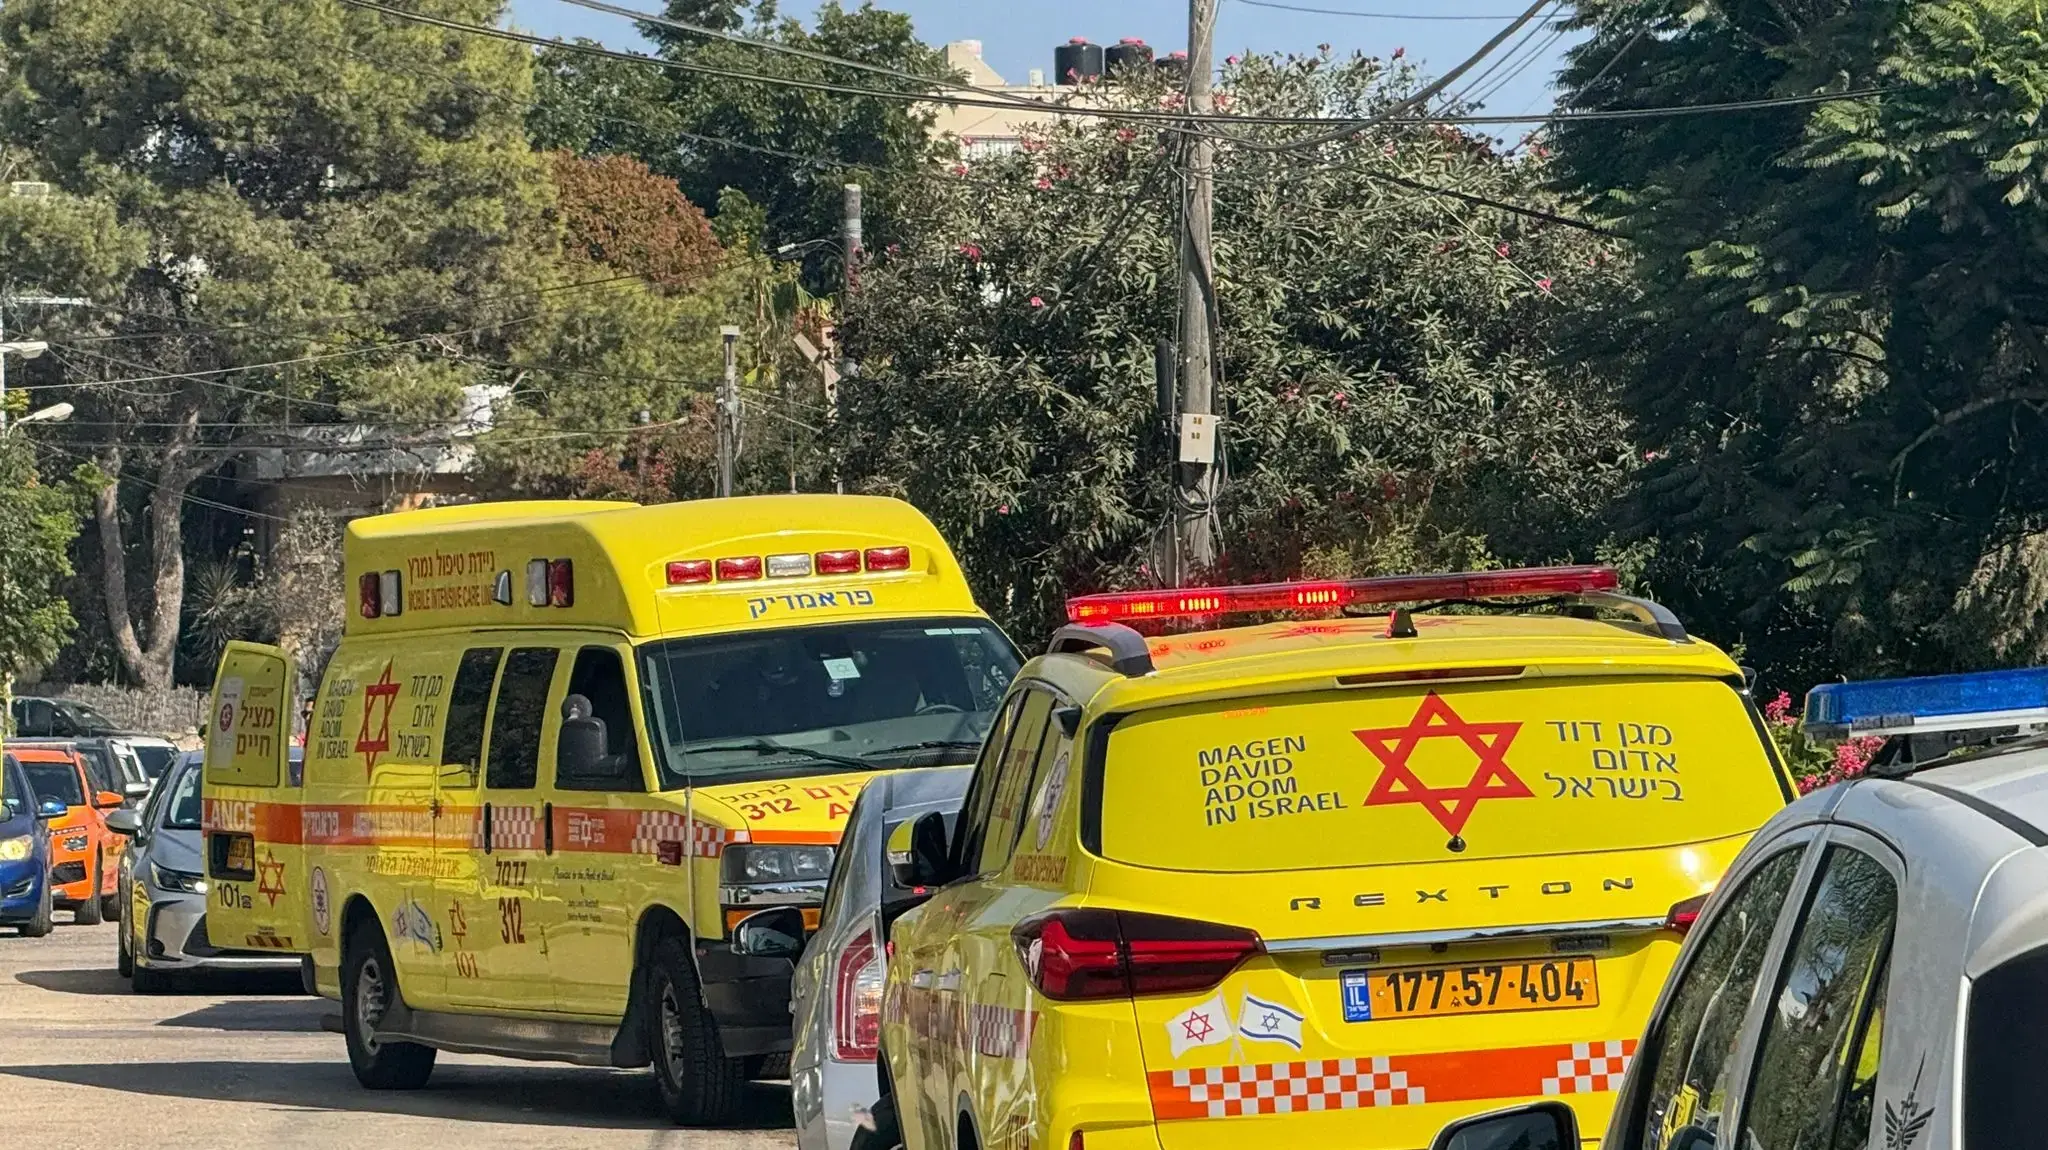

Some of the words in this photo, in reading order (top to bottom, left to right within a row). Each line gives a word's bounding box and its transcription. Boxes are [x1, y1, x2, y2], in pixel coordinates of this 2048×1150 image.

[408, 556, 433, 584] נמרץ
[436, 549, 464, 576] טיפול
[469, 551, 495, 574] ניידת
[747, 590, 874, 619] פראמדיק
[241, 700, 275, 728] מציל
[412, 704, 437, 728] אדום
[236, 733, 270, 757] חיים
[397, 730, 432, 758] בישראל
[1545, 721, 1602, 742] דוד
[1618, 723, 1673, 747] מגן
[326, 740, 349, 759] ISRAEL
[1198, 735, 1306, 767] MAGEN
[1592, 749, 1680, 774] אדום
[1200, 757, 1293, 787] DAVID
[720, 783, 791, 803] כרמל
[1204, 776, 1298, 807] ADOM
[1544, 772, 1685, 801] בישראל
[741, 798, 800, 820] 312
[1206, 804, 1237, 826] IN
[1248, 792, 1348, 819] ISRAEL
[496, 856, 527, 886] כרמל
[217, 883, 241, 908] 101
[1290, 877, 1634, 911] REXTON
[499, 897, 526, 944] 312
[455, 951, 479, 978] 101
[1349, 986, 1366, 1006] IL
